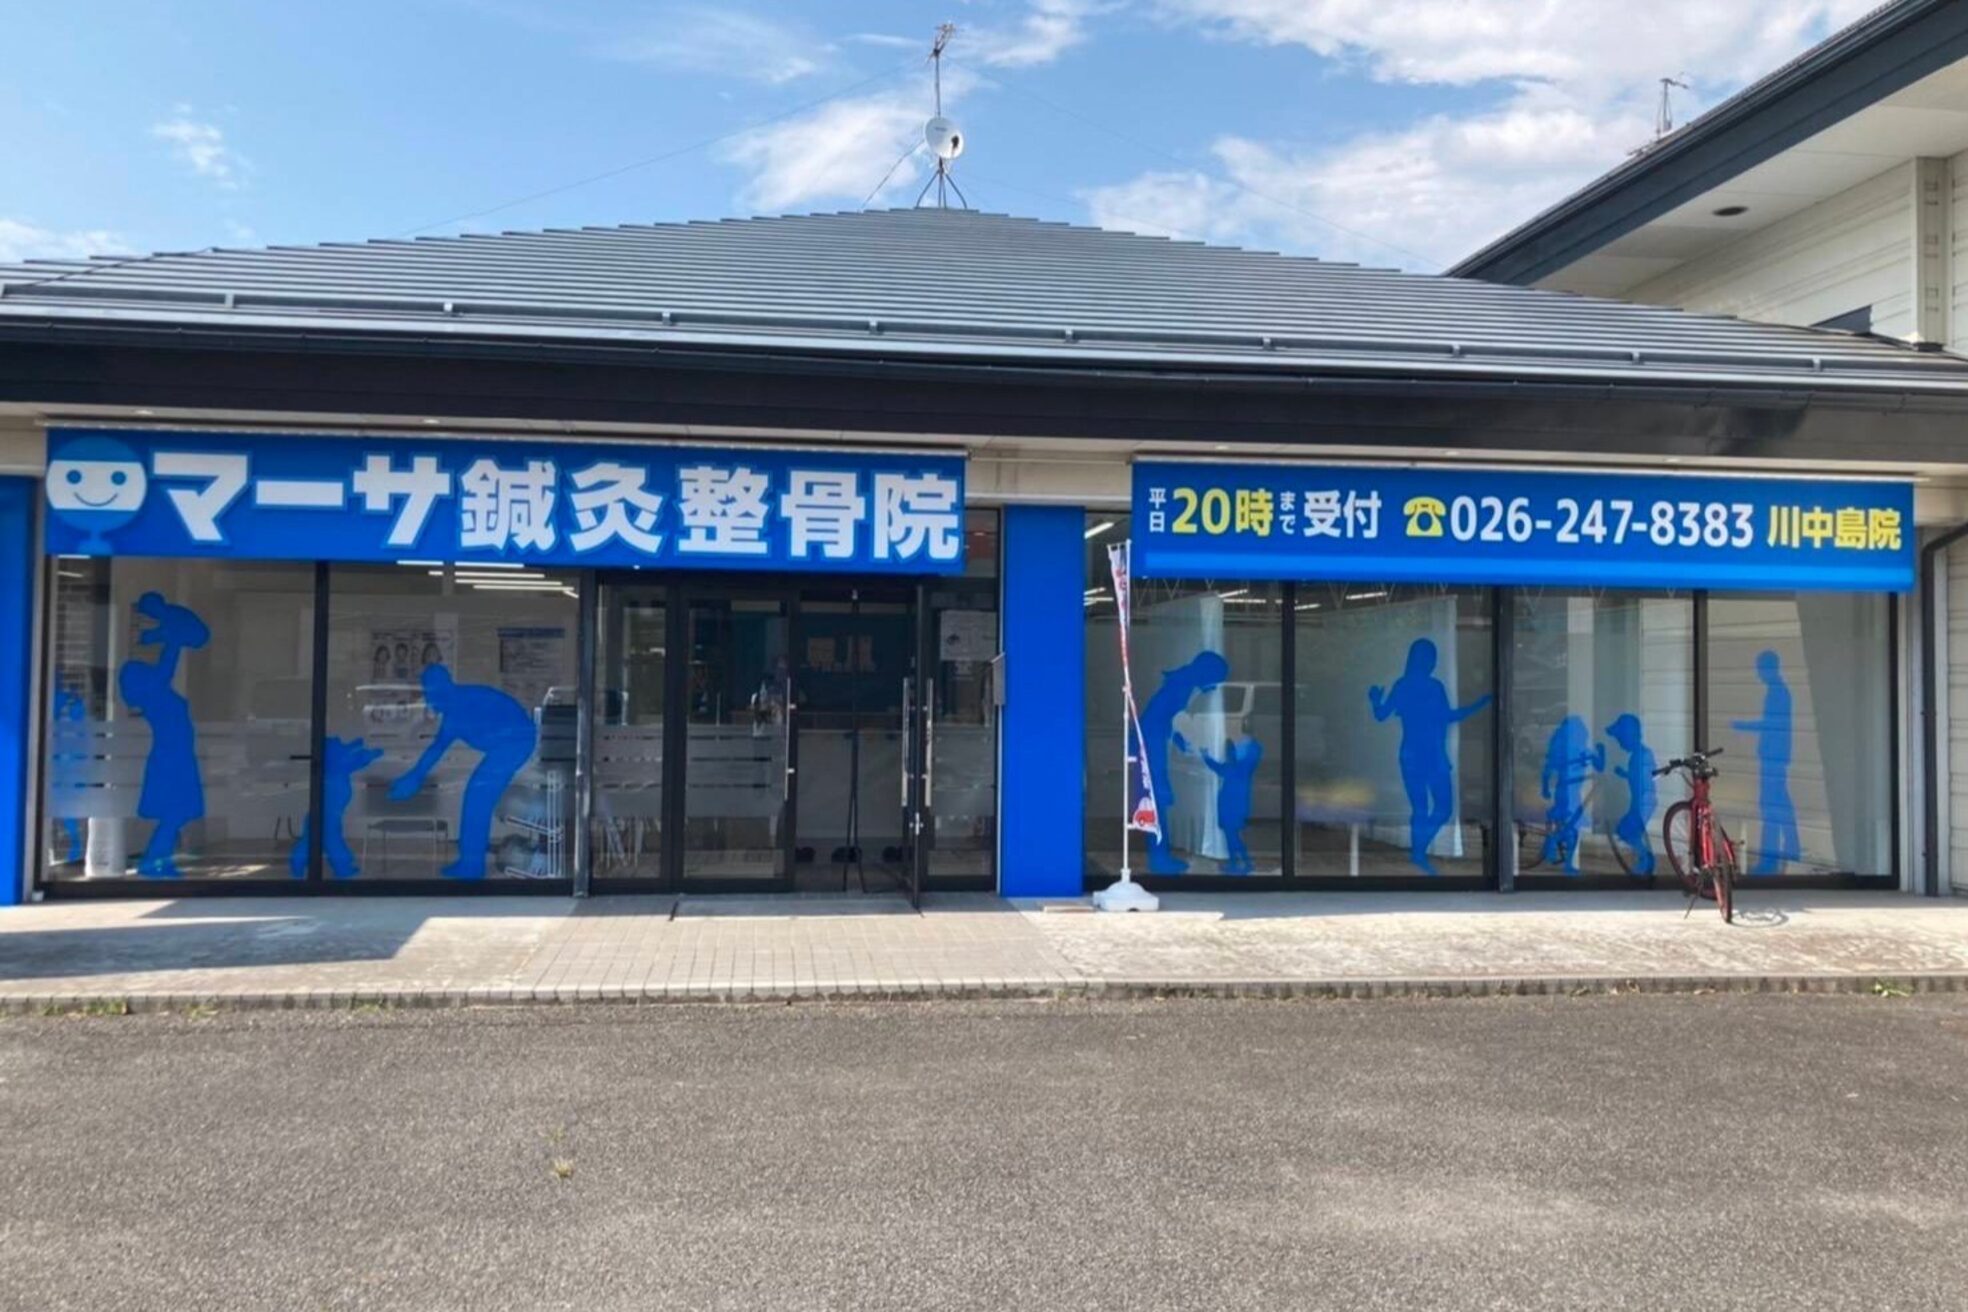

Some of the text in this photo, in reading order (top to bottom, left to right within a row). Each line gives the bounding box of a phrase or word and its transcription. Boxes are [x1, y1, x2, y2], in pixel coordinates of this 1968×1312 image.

[153, 452, 960, 561] マーサ鍼灸整骨院
[1450, 496, 1755, 548] 026-247-8383
[1766, 505, 1902, 550] 川中島院
